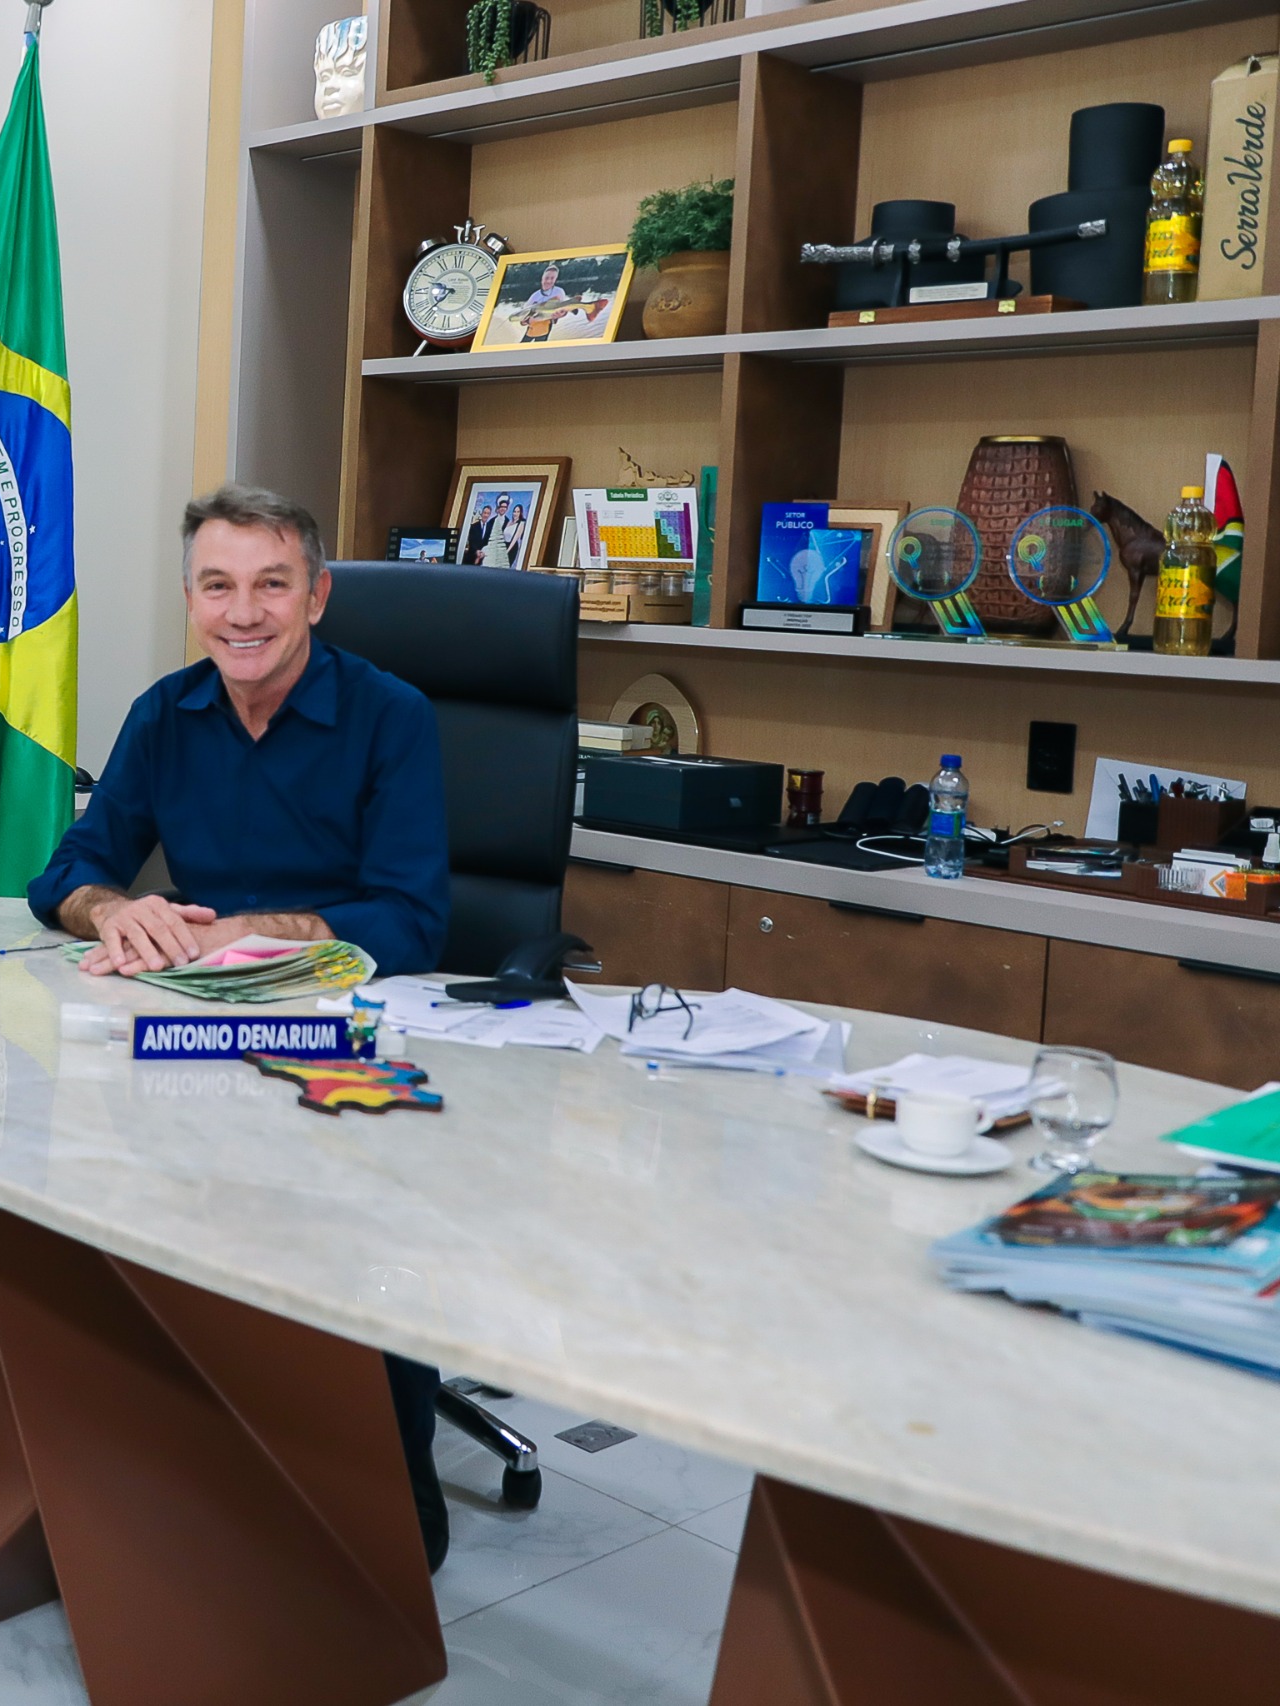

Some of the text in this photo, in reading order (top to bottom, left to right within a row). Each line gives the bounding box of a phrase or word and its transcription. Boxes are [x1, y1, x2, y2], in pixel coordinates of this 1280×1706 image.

[1220, 101, 1267, 271] Serra Verde
[0, 481, 14, 492] E
[775, 519, 814, 529] PÚBLICO
[4, 496, 25, 628] PROGRESSO
[141, 1023, 337, 1051] ANTONIO DENARIUM
